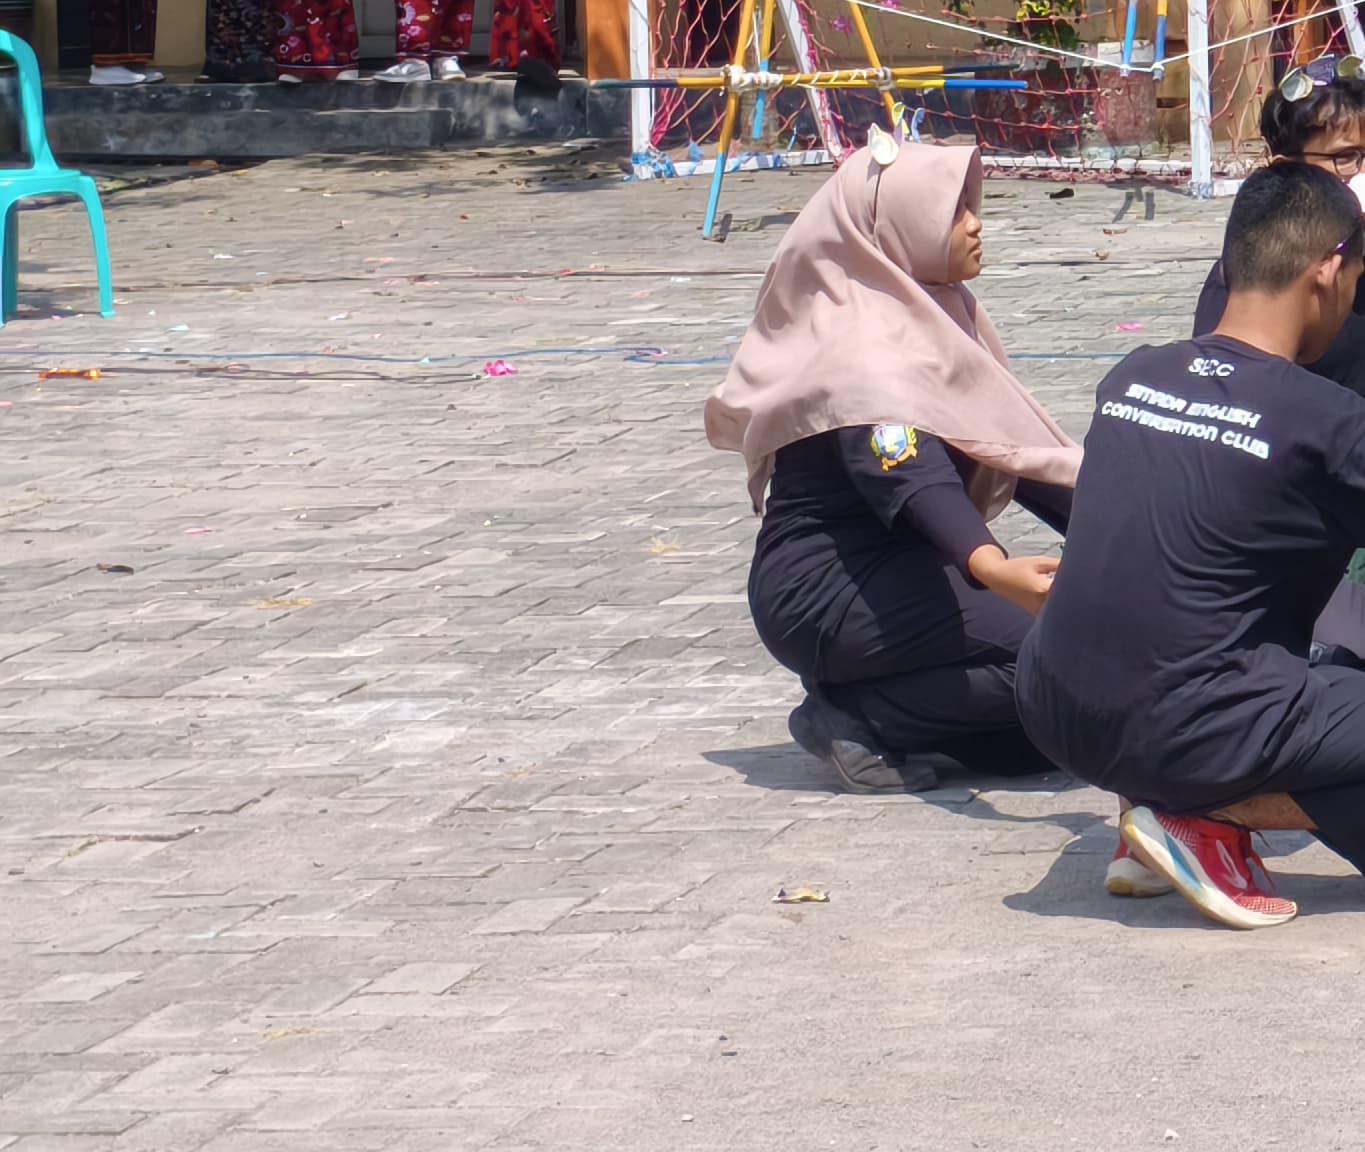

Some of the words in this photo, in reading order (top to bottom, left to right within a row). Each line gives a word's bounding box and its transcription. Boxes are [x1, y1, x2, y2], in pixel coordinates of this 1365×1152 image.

[1101, 401, 1219, 442] CONVERSATION
[1221, 430, 1270, 460] CLUB
[1125, 383, 1187, 413] SMADA
[1185, 402, 1262, 429] ENGLISH
